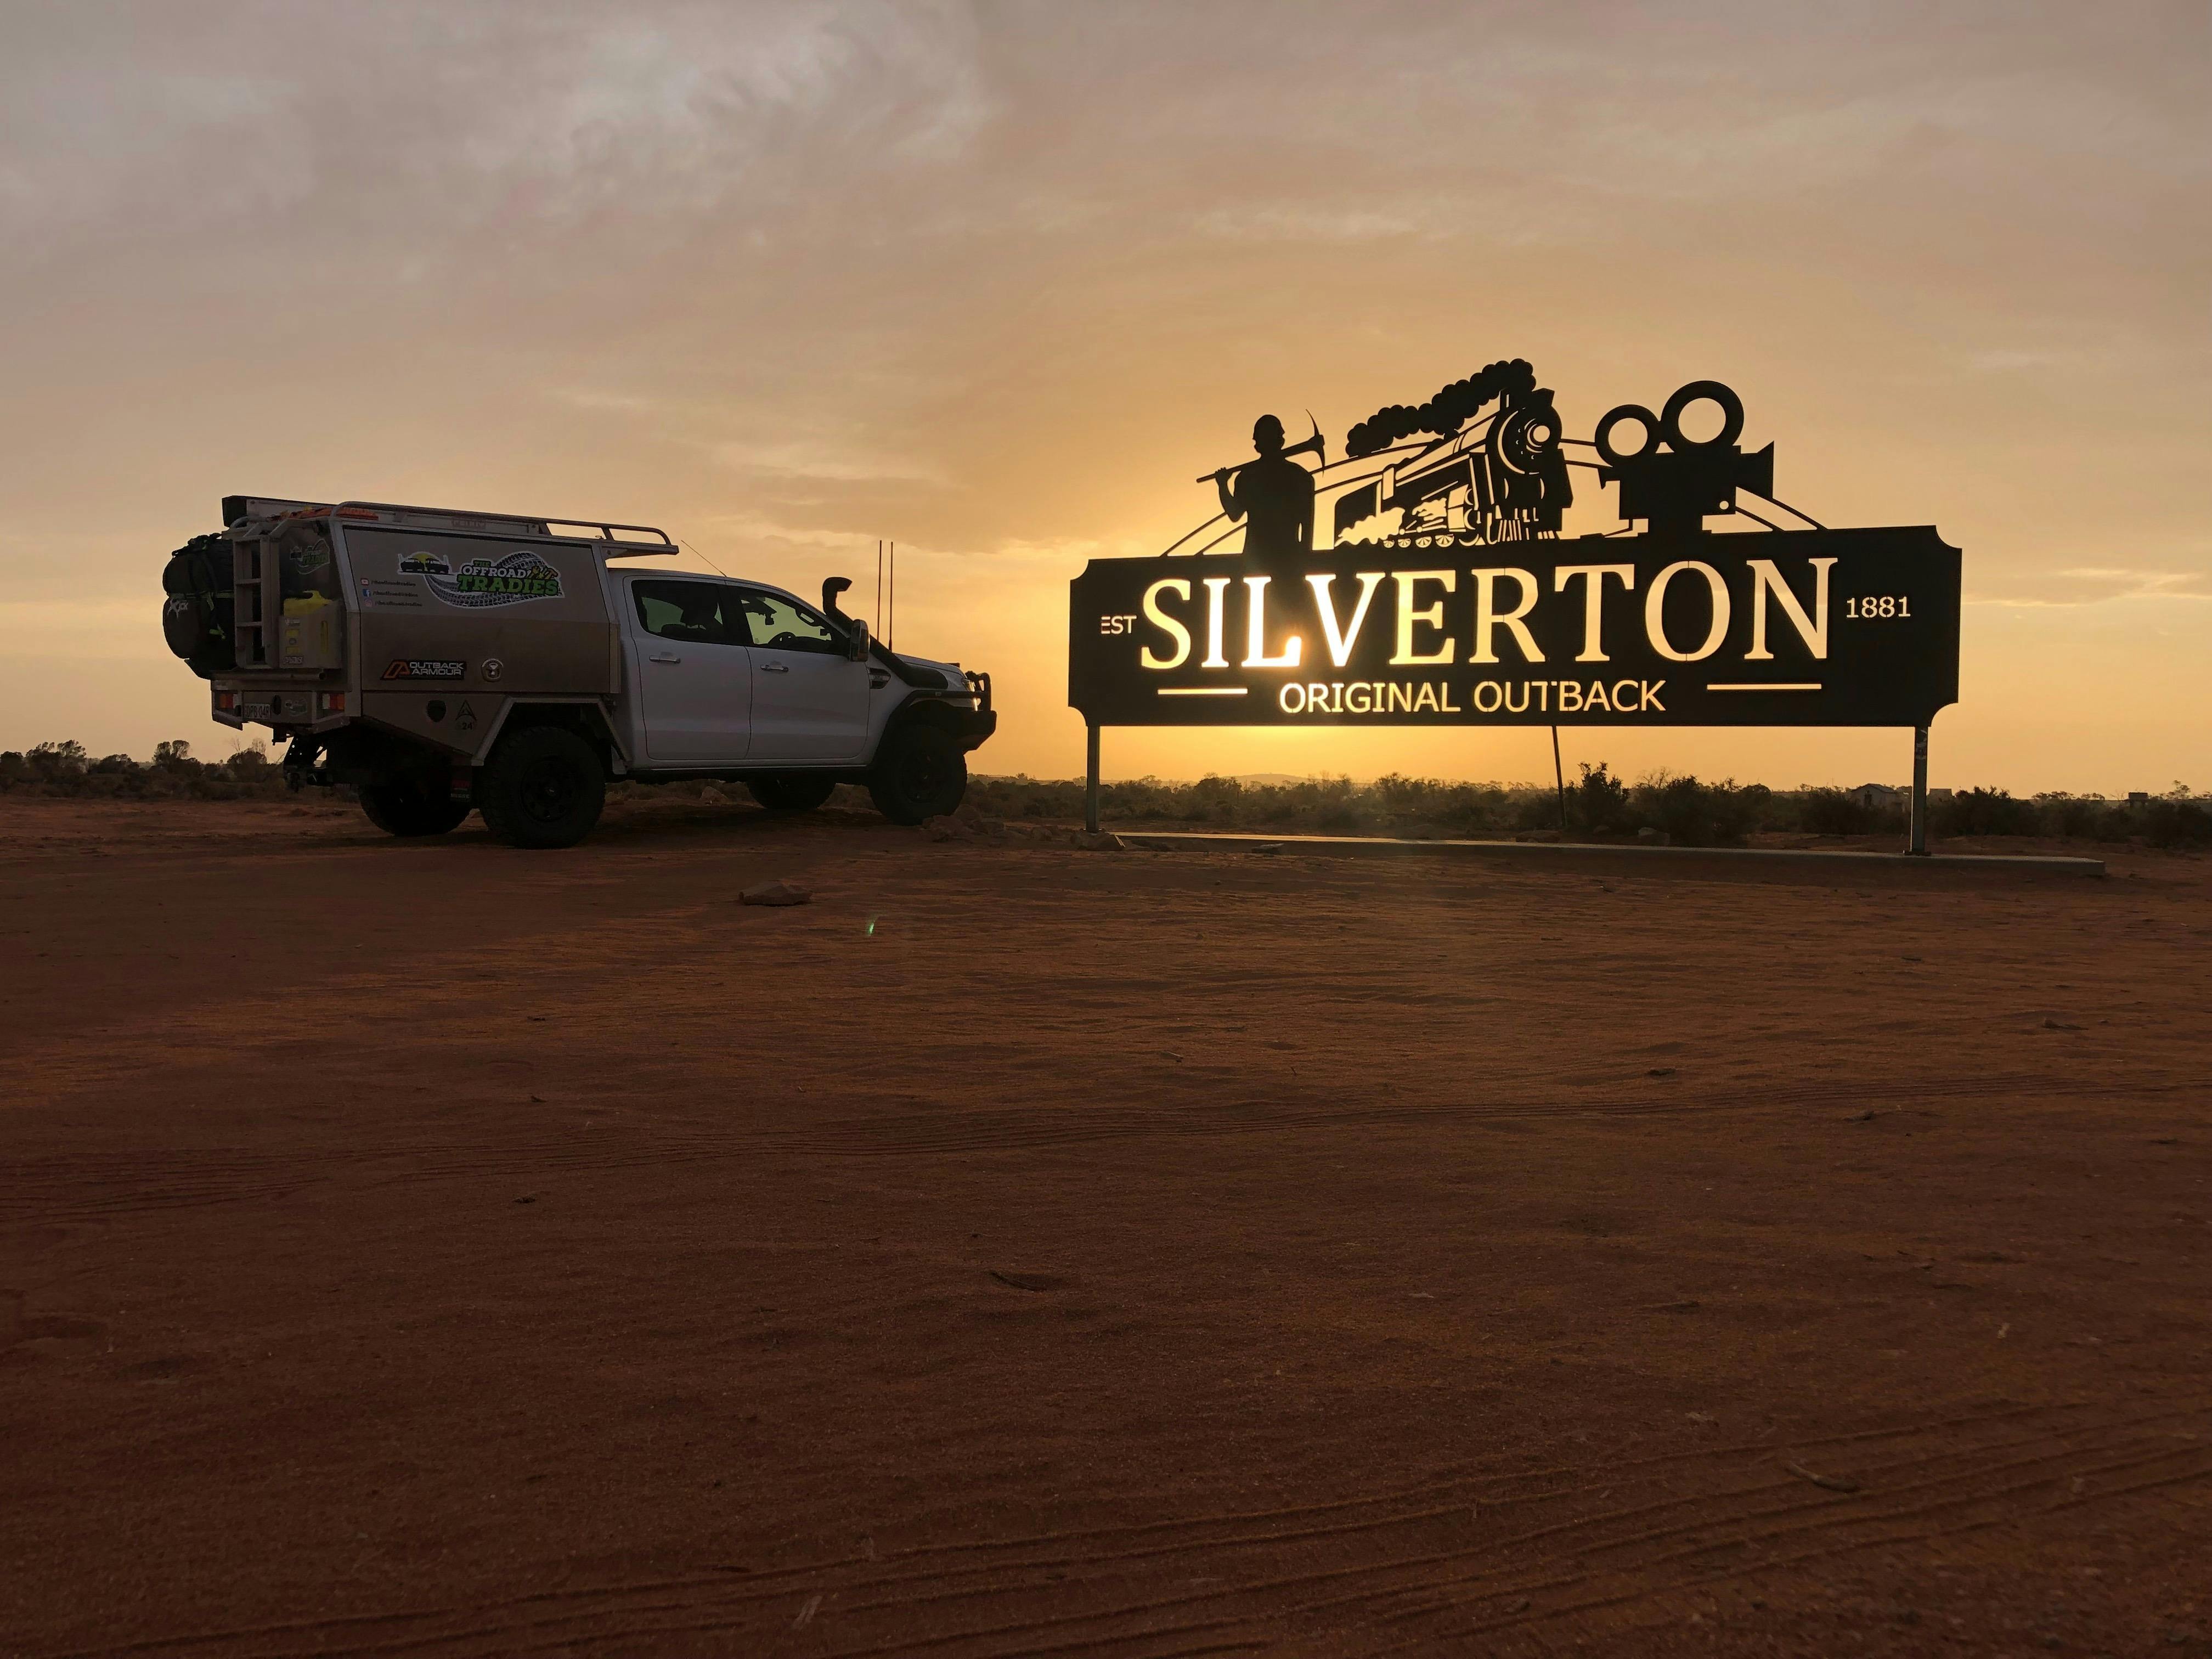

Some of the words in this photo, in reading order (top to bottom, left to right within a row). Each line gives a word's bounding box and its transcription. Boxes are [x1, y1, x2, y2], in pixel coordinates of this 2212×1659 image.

[462, 566, 528, 578] OFFROAD
[458, 574, 558, 595] TRADIES
[1141, 558, 1838, 670] SILVERTON
[1846, 596, 1911, 618] 1881
[1101, 615, 1137, 635] EST
[1279, 681, 1461, 713] ORIGINAL
[1474, 680, 1666, 713] OUTBACK
